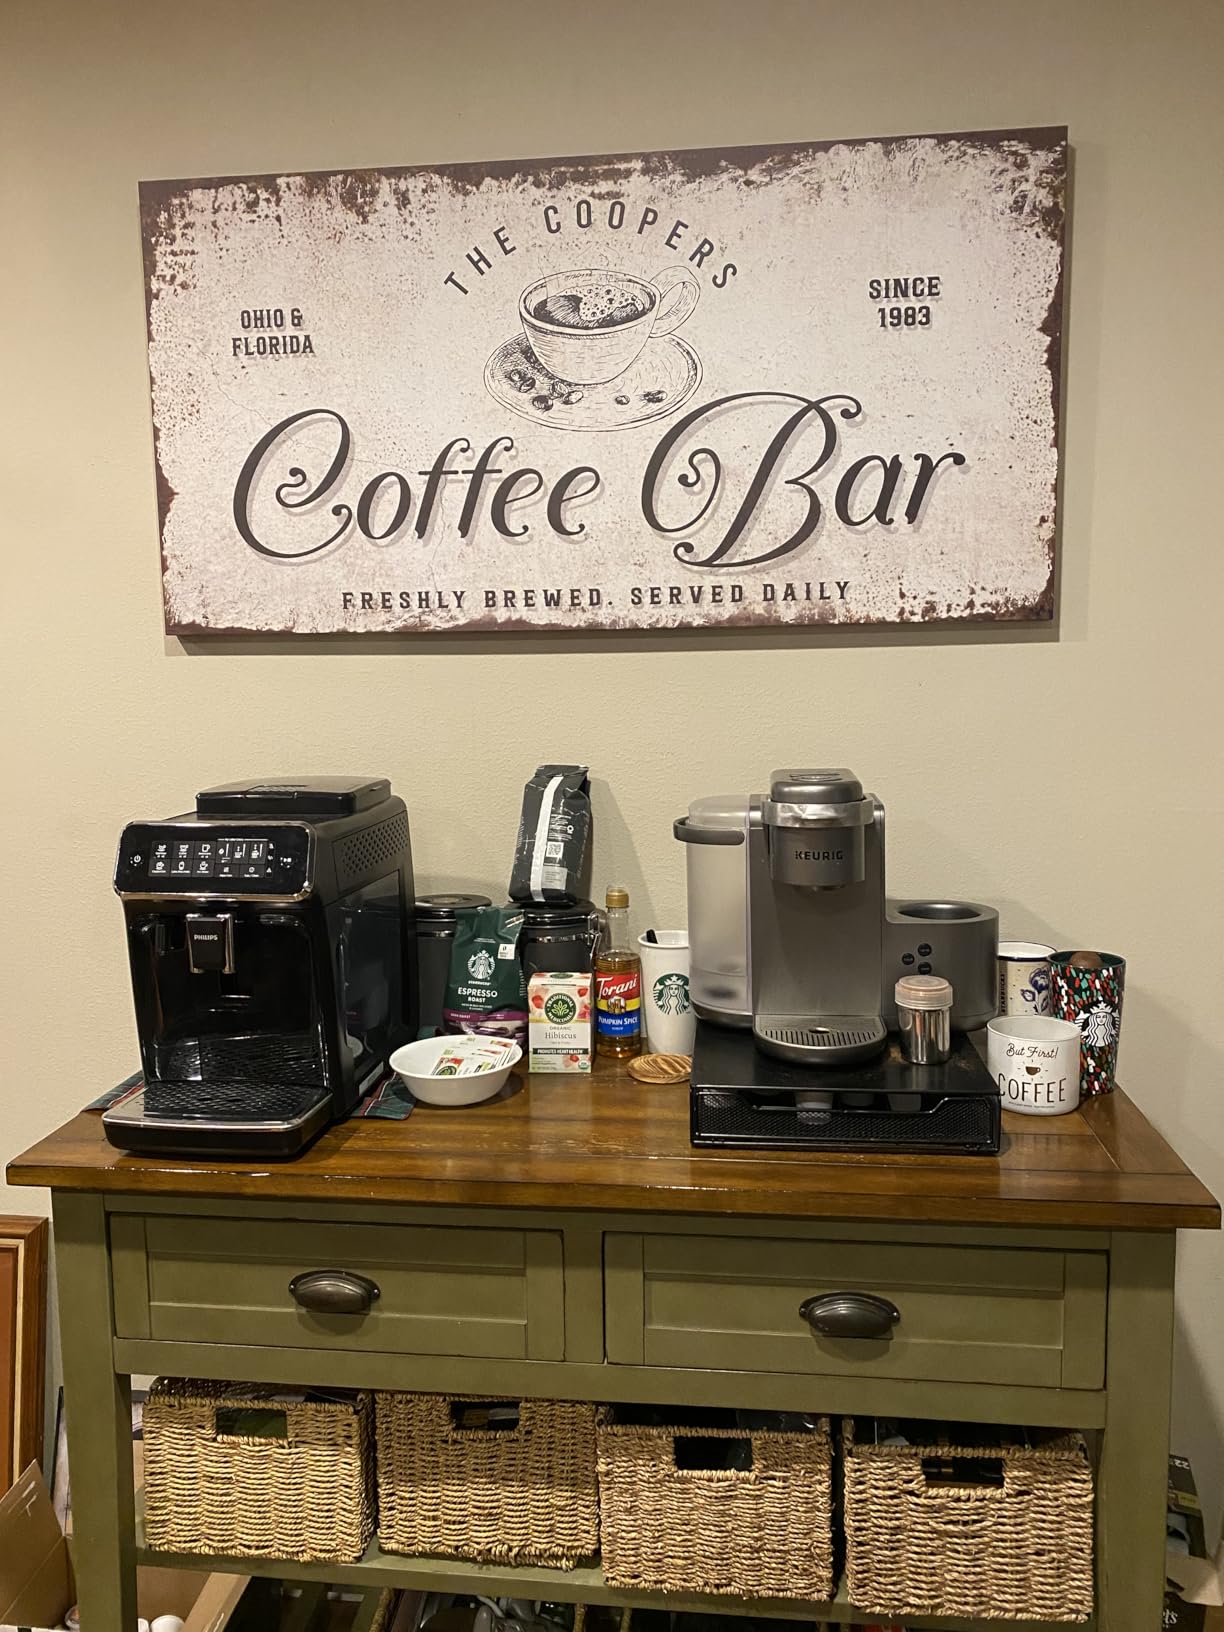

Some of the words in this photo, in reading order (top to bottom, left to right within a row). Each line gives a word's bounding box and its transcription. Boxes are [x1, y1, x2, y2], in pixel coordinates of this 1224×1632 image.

[444, 226, 517, 296] THE
[543, 199, 738, 289] COOPERS
[868, 275, 942, 300] SINCE
[240, 308, 284, 330] OHIO
[290, 307, 304, 328] &
[877, 305, 932, 329] 1983
[231, 333, 315, 357] FLORIDA
[232, 408, 601, 559] Coffee
[641, 391, 967, 568] Bar
[341, 588, 467, 611] FRESHLY
[484, 586, 614, 609] BREWED.
[630, 583, 744, 606] SERVED
[762, 580, 851, 603] DAILY
[794, 850, 844, 861] KEURIG
[193, 933, 218, 941] PHILIPS
[457, 986, 498, 998] ESPRESSO
[596, 974, 638, 1001] Torani
[544, 1031, 577, 1040] Hibiscus
[1005, 1042, 1025, 1058] But
[1026, 1045, 1059, 1059] First!
